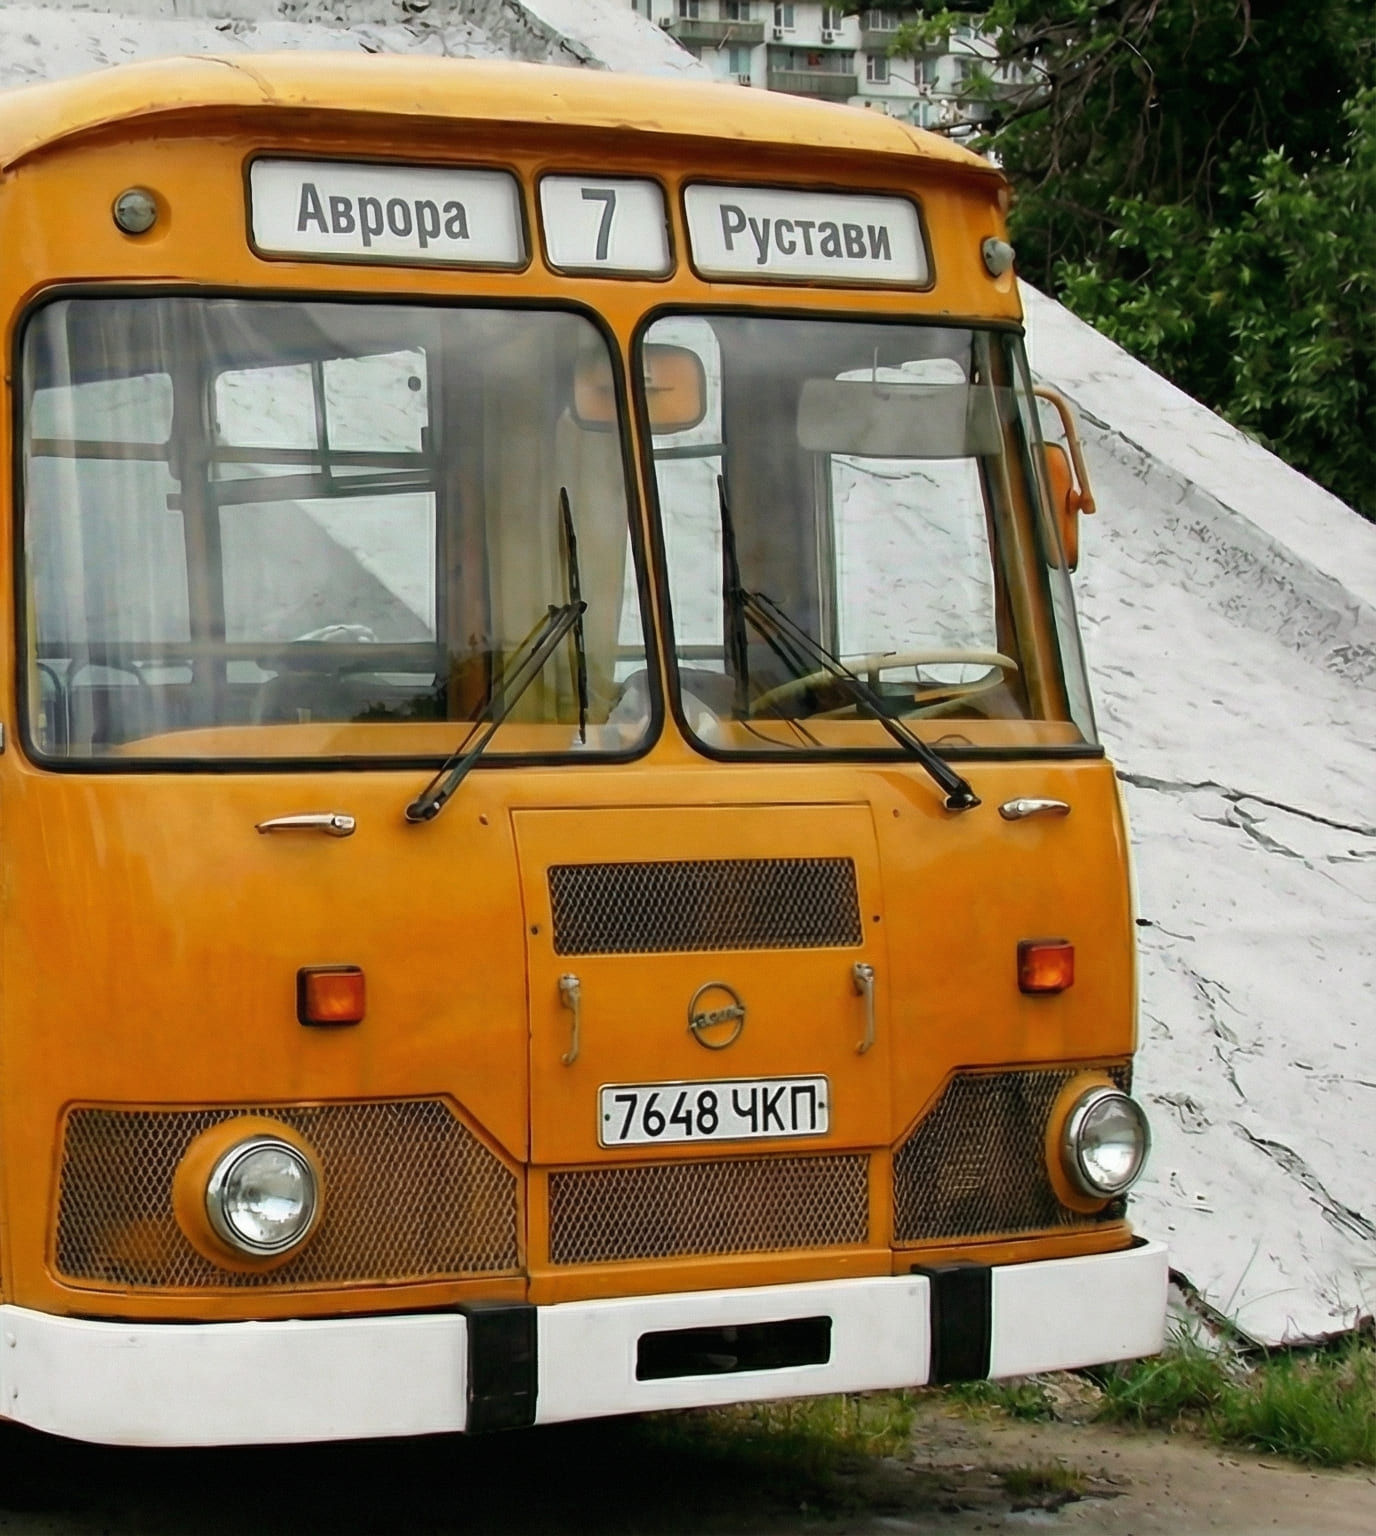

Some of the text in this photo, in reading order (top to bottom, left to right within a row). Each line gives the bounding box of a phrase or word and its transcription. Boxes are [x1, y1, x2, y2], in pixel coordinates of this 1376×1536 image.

[297, 183, 470, 248] Аврора
[581, 188, 617, 260] 7
[720, 204, 892, 265] Рустави
[615, 1085, 816, 1140] 7648 ЧКП
